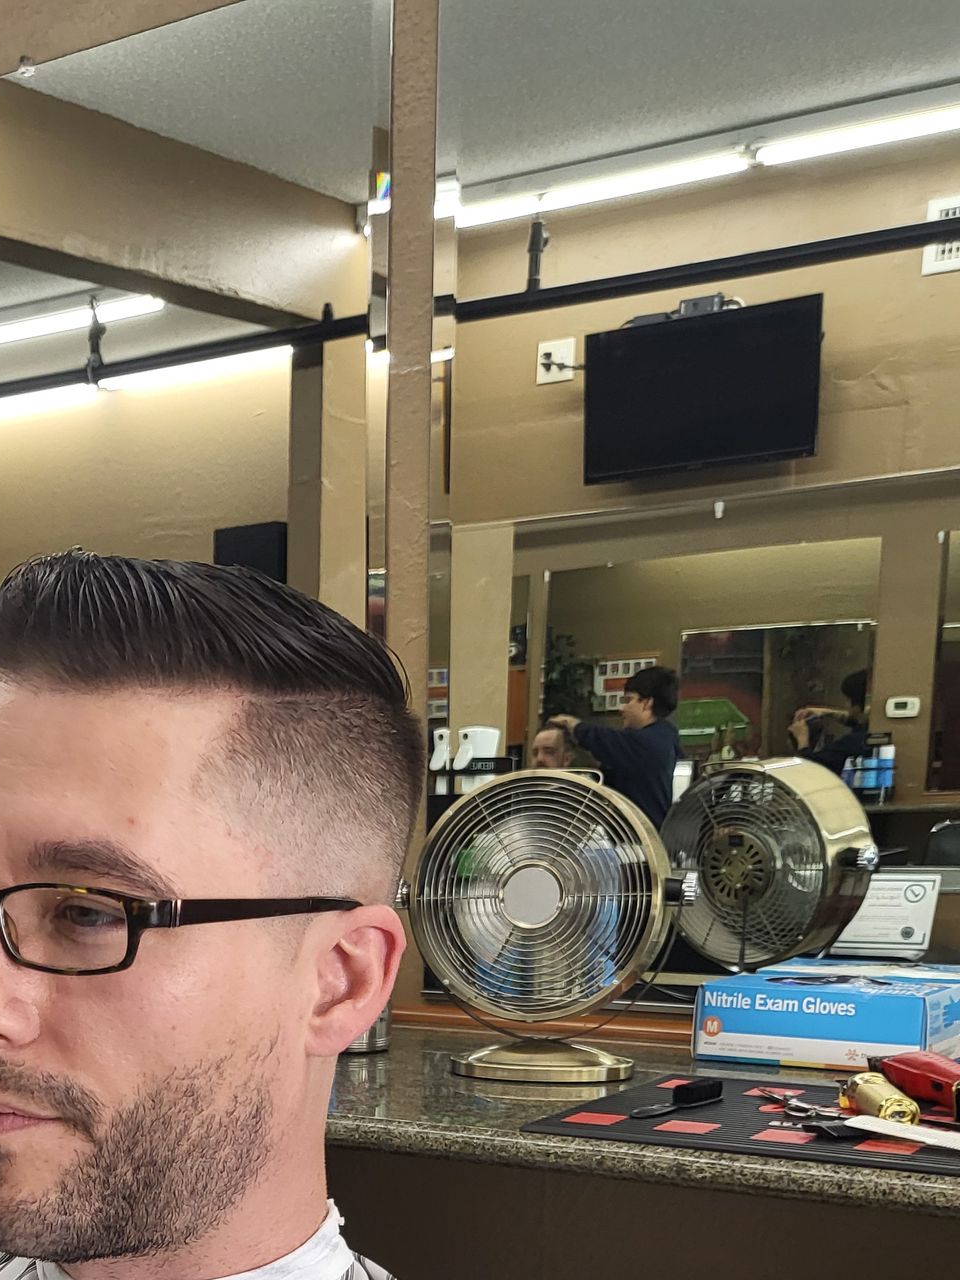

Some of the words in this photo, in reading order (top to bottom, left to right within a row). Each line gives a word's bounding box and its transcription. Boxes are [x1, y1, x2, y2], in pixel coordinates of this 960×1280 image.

[704, 991, 751, 1010] Nitrile
[755, 994, 799, 1013] Exam
[802, 996, 856, 1016] Gloves
[706, 1020, 718, 1034] M
